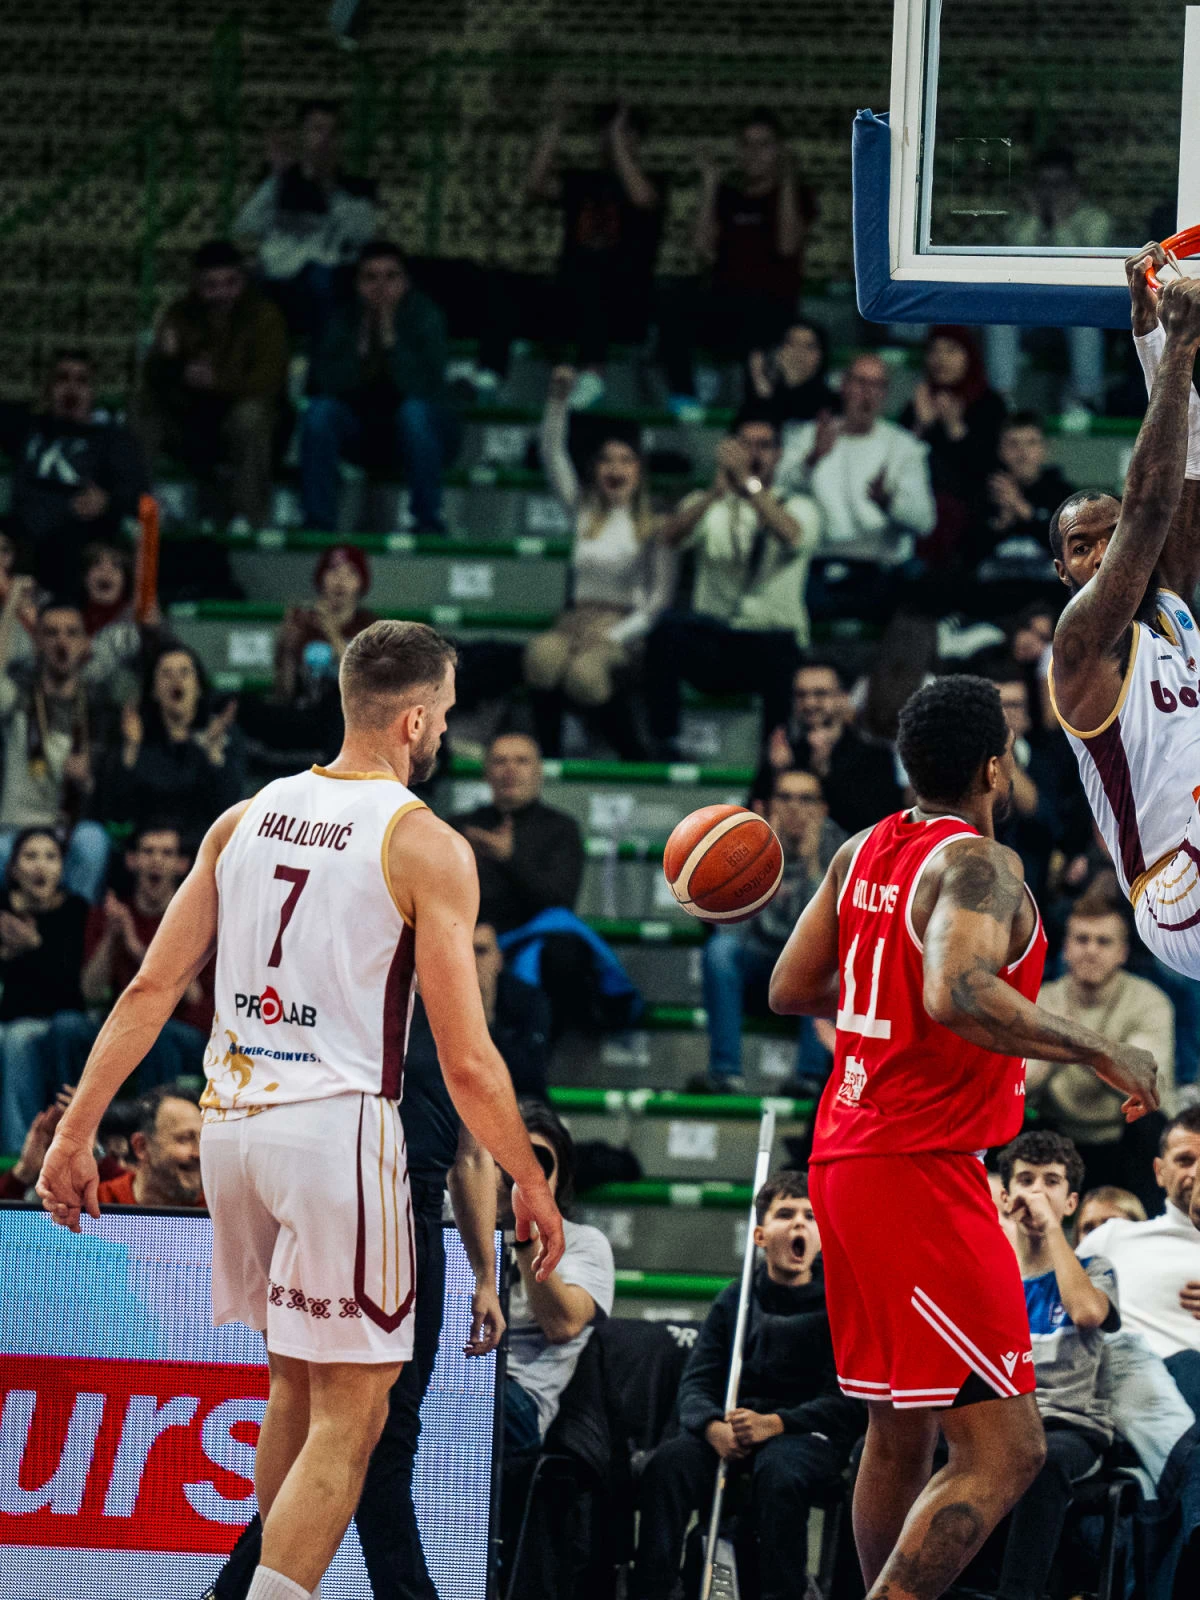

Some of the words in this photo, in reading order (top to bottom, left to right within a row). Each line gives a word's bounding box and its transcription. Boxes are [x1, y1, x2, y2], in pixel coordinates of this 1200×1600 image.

[257, 812, 354, 851] HALILOVIĆ
[267, 864, 310, 968] 7
[234, 985, 317, 1028] PROLAB
[836, 933, 892, 1040] 11
